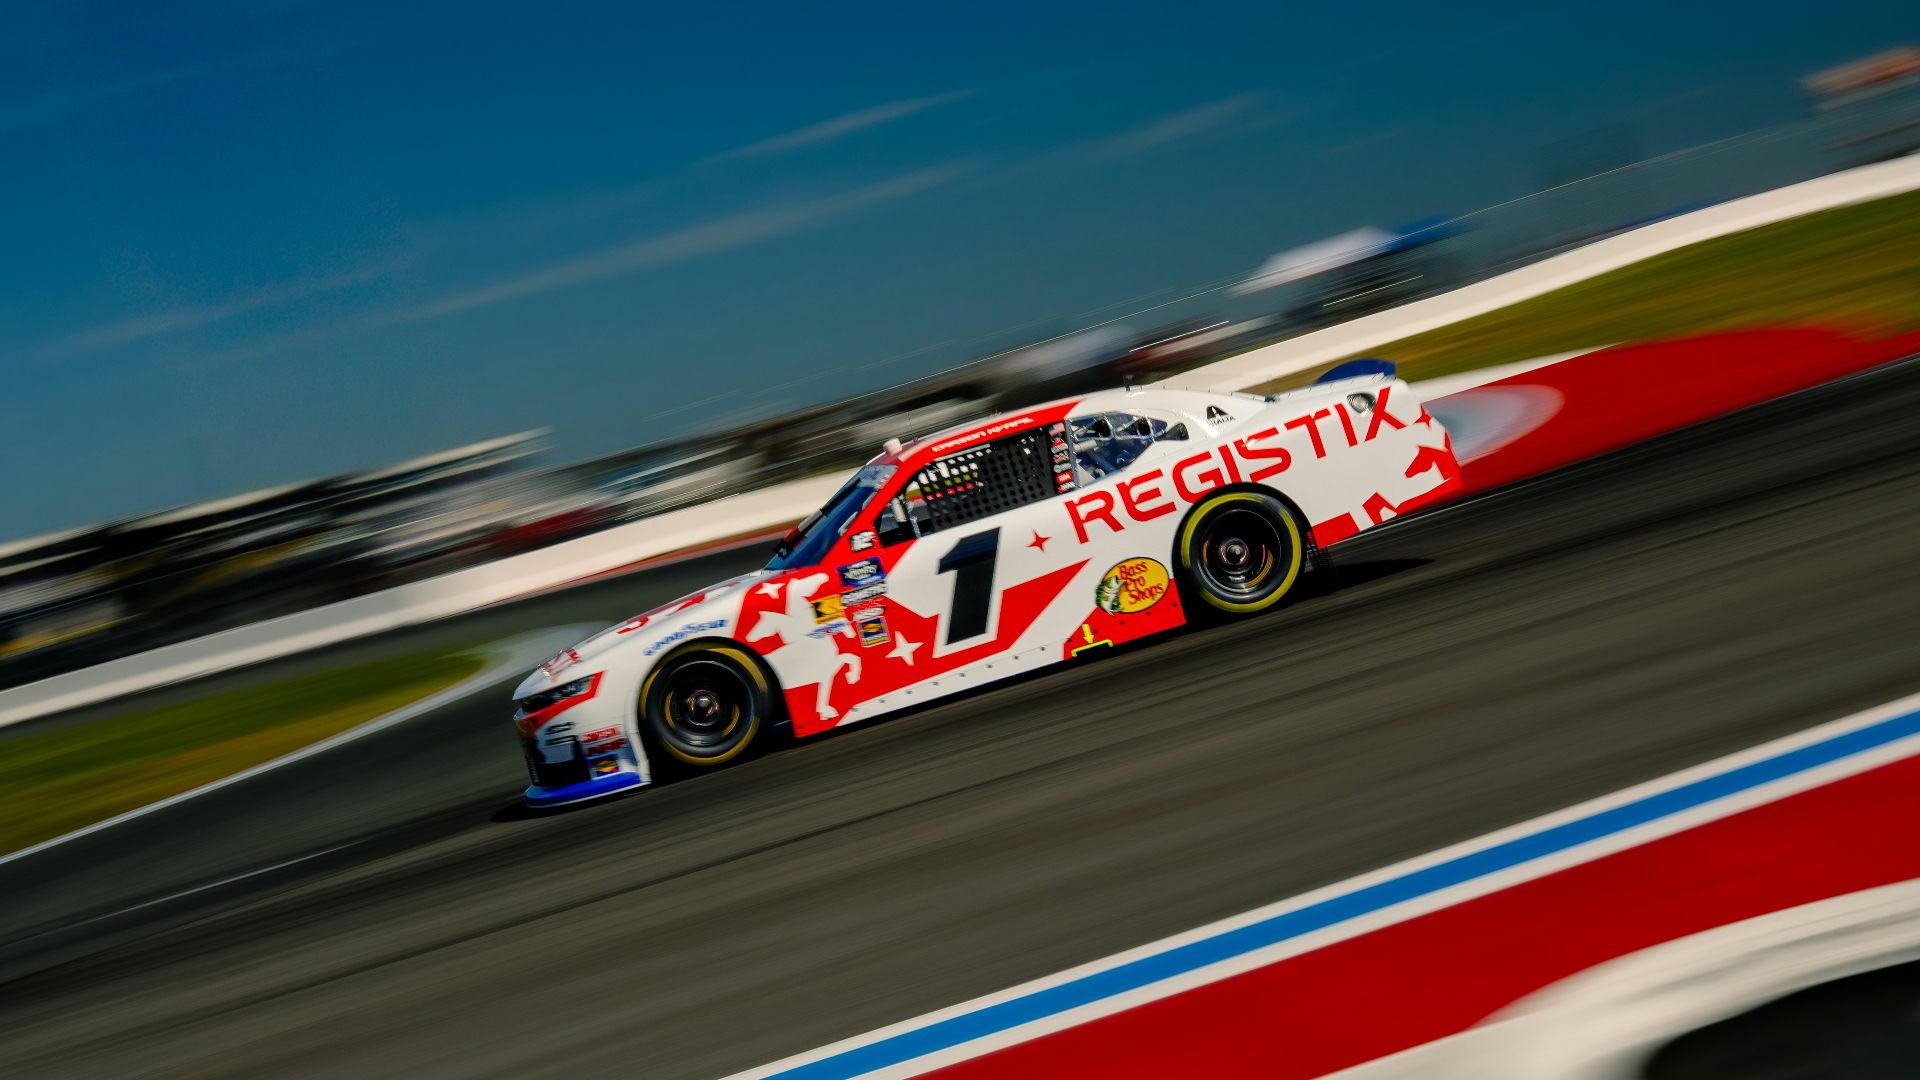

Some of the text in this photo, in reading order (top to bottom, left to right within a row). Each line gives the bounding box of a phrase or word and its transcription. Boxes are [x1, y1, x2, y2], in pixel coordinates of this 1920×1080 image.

[1064, 386, 1407, 544] REGISTIX
[936, 526, 1002, 646] 1
[1118, 561, 1148, 581] Bass
[1128, 583, 1164, 605] Shops
